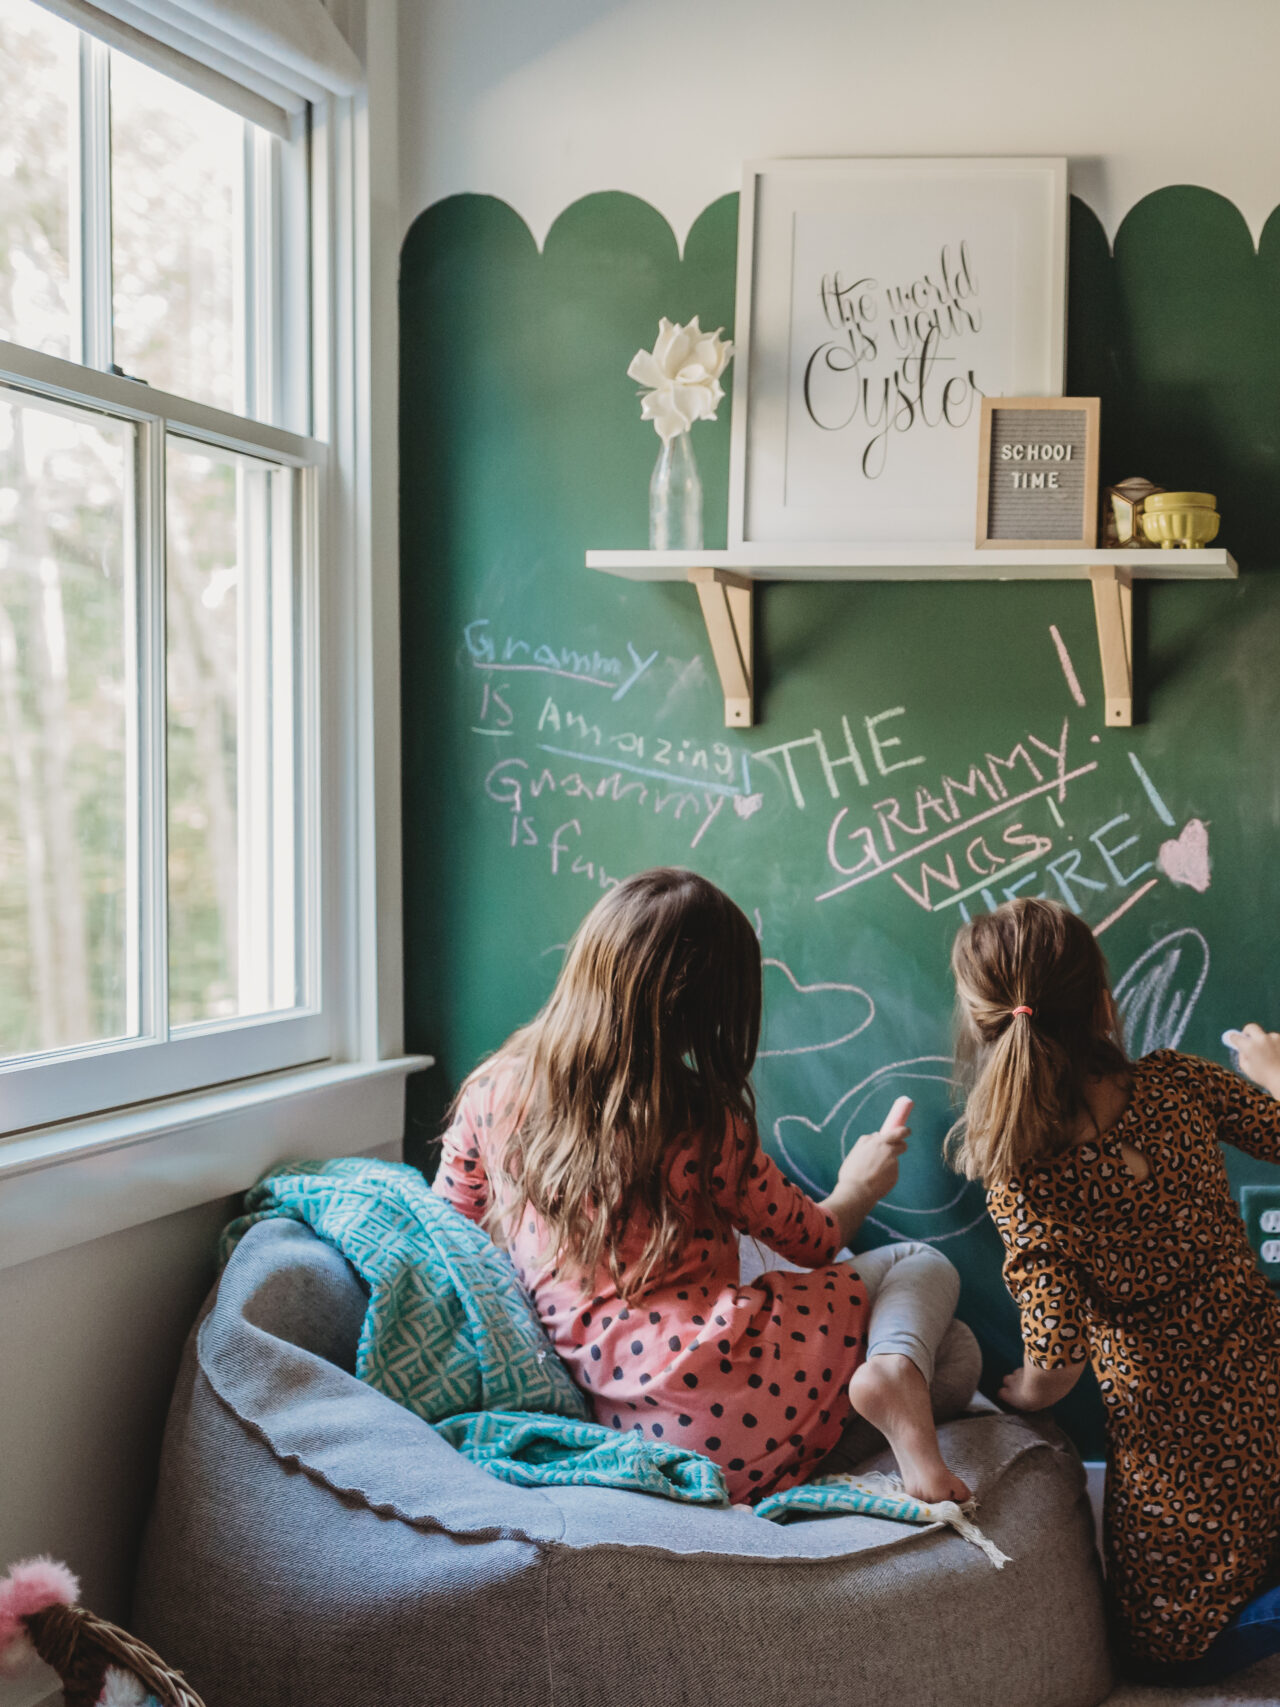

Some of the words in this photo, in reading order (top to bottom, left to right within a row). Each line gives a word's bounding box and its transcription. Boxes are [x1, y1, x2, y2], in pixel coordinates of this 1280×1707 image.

[817, 270, 878, 331] the
[886, 239, 980, 315] world
[891, 298, 983, 384] your
[1011, 471, 1060, 489] TIME
[751, 706, 926, 810] THE
